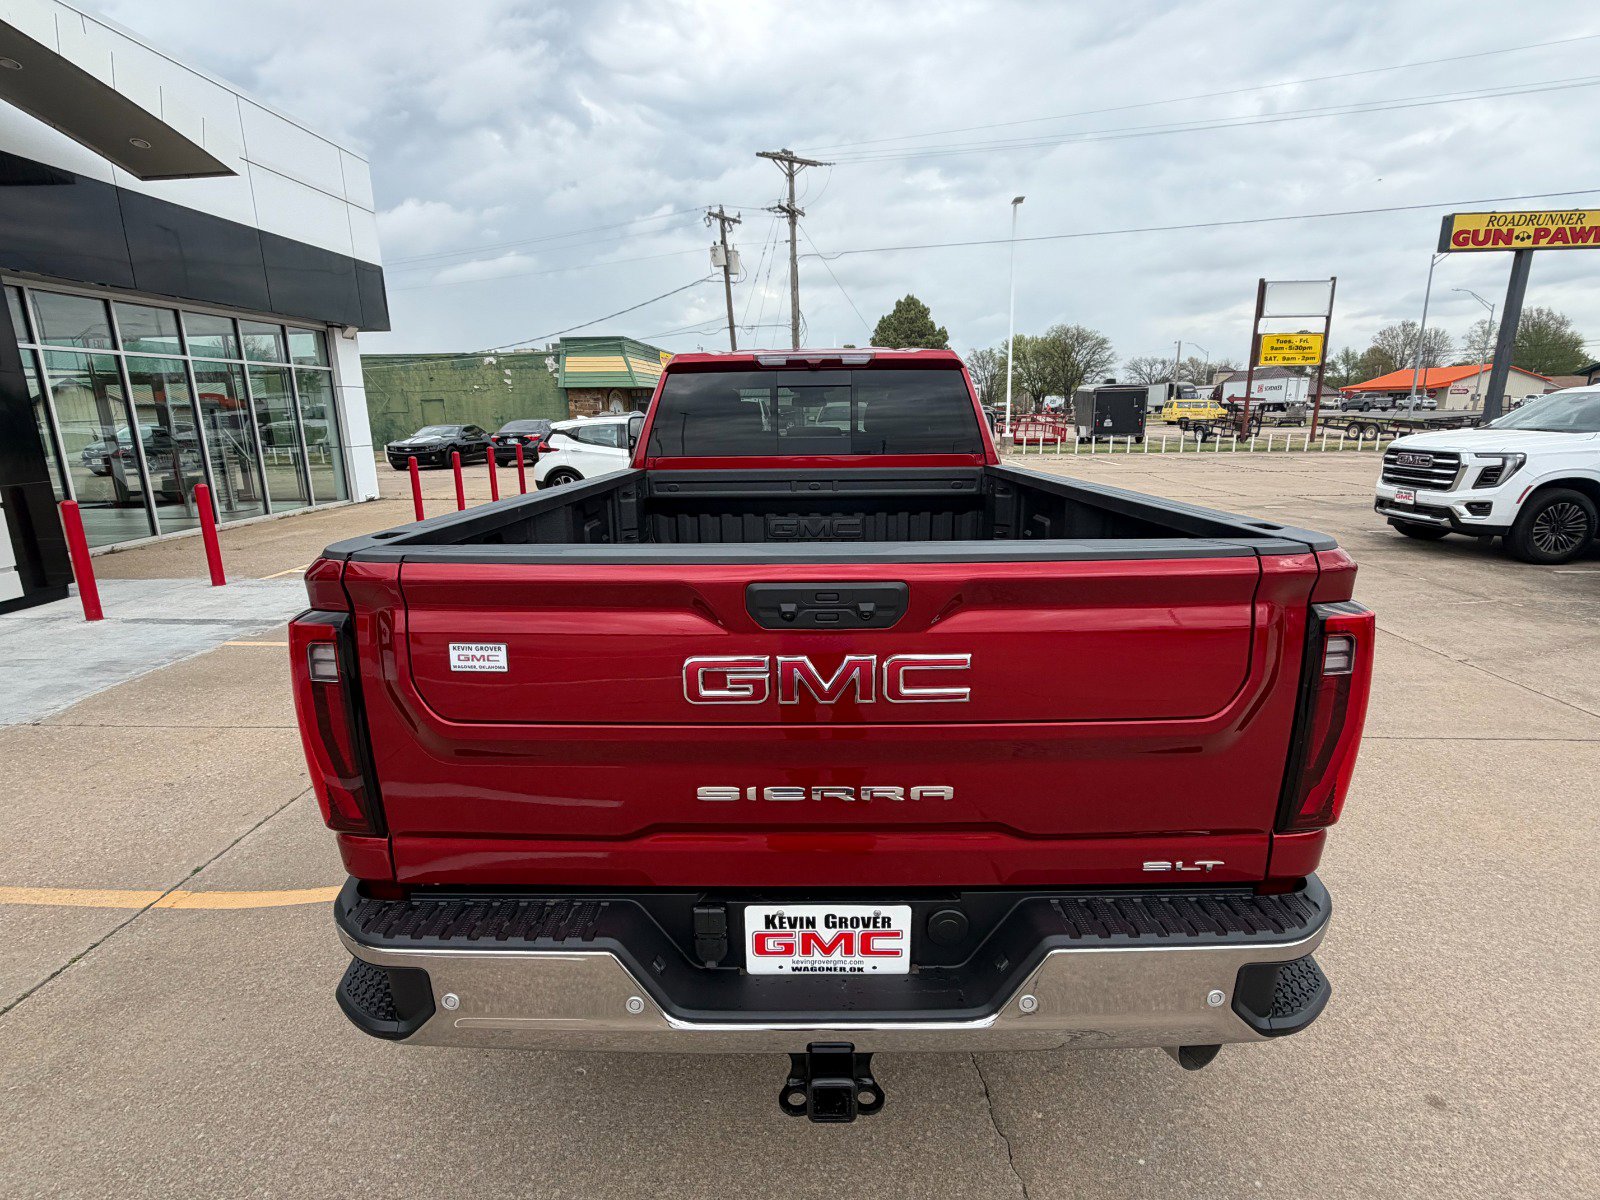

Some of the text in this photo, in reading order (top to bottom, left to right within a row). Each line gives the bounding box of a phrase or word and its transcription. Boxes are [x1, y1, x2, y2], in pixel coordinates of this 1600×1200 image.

[1486, 213, 1586, 227] ROADRUNNER
[1452, 228, 1515, 247] GUN
[1398, 453, 1433, 467] GMC
[1395, 493, 1414, 501] GMC
[769, 517, 863, 537] GMC
[457, 654, 500, 662] GMC
[682, 653, 972, 705] GMC
[696, 785, 955, 801] SIERRA
[1143, 861, 1225, 873] SLT
[752, 930, 904, 958] GMC
